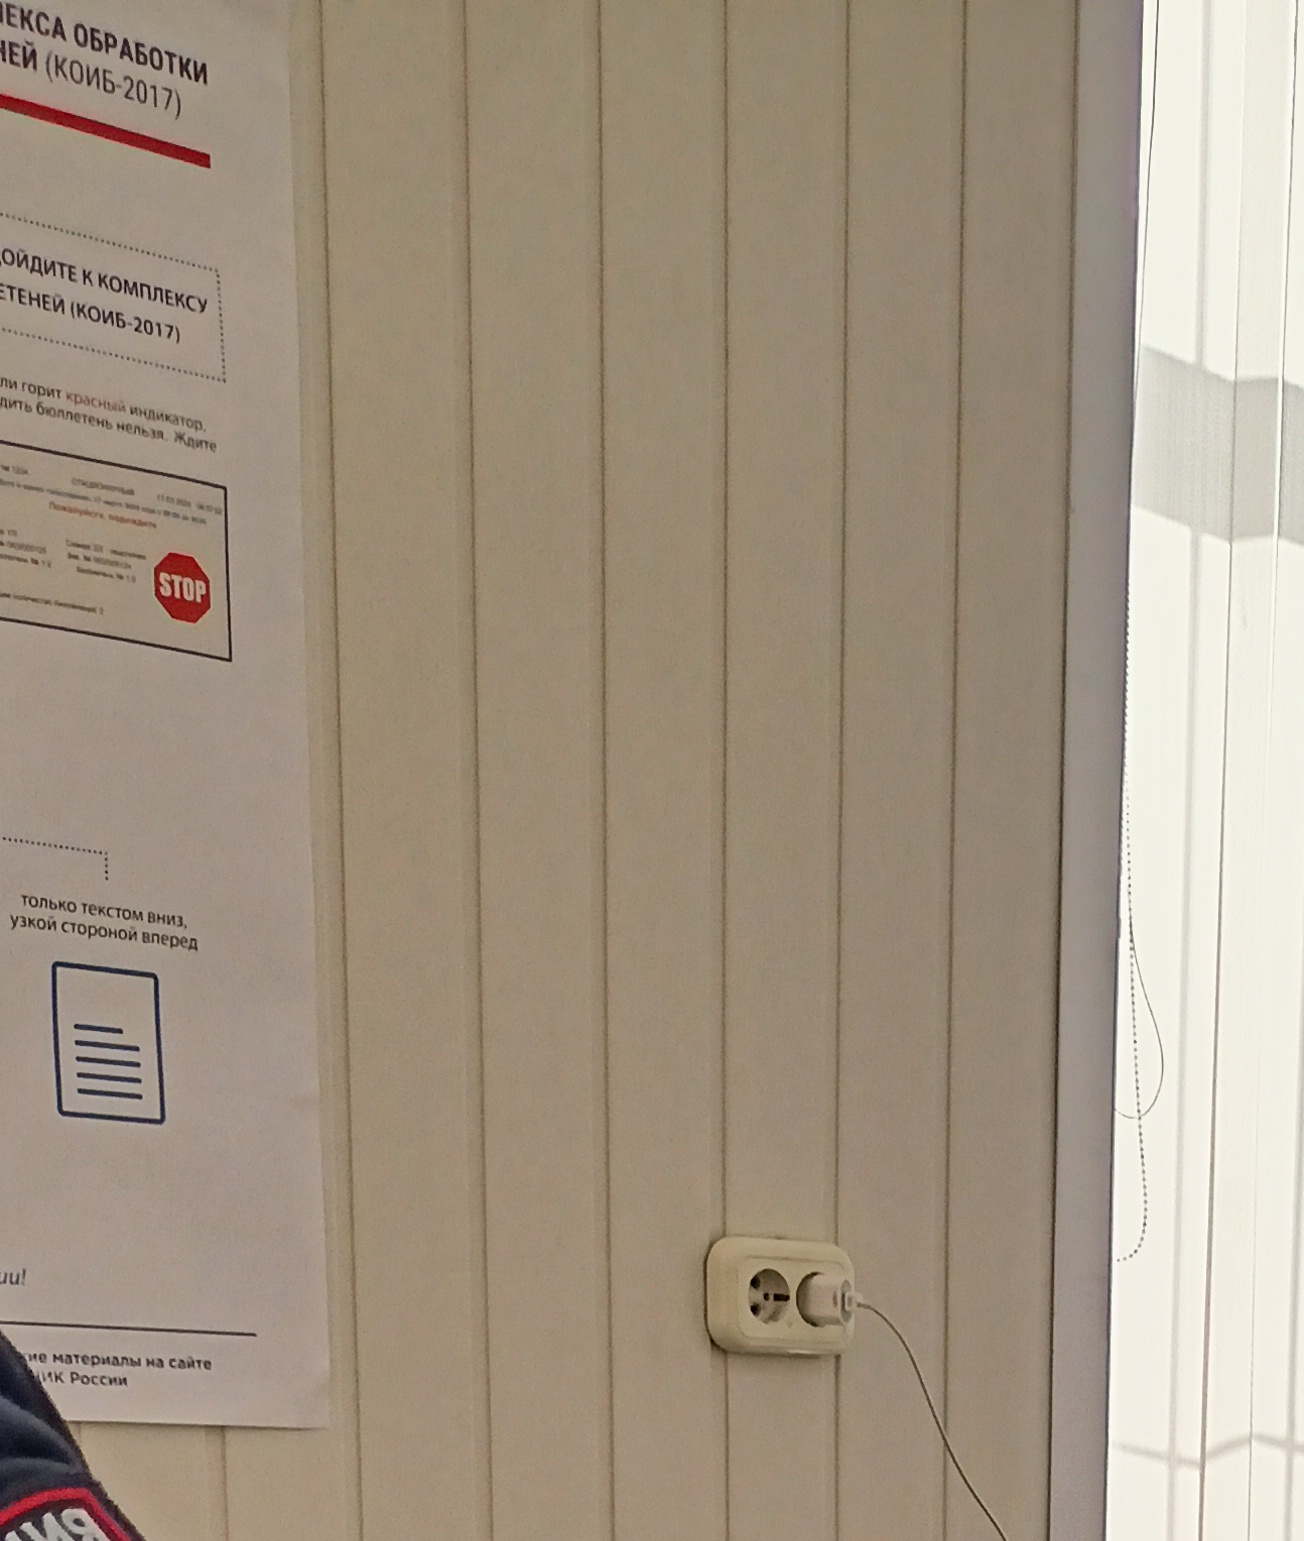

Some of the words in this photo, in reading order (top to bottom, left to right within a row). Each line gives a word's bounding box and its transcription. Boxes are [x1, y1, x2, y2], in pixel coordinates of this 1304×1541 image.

[0, 2, 67, 42] ЕКСА
[73, 23, 208, 86] ОБРАБОТКИ
[45, 50, 182, 120] (КОИБ-2017)
[0, 248, 78, 283] ОЙДИТЕ
[82, 269, 94, 287] К
[98, 271, 208, 314] КОМПЛЕКСУ
[70, 301, 181, 344] (КОИБ-2017)
[21, 380, 62, 399] горит
[66, 391, 126, 413] красный
[36, 402, 113, 430] бюллетень
[173, 431, 218, 453] Ждите
[158, 572, 206, 603] STOP
[21, 895, 77, 913] только
[82, 902, 144, 921] текстом
[10, 914, 57, 931] узкой
[61, 921, 138, 941] стороной
[142, 931, 198, 951] вперед
[23, 1352, 47, 1364] ие
[53, 1353, 142, 1368] материалы
[146, 1357, 164, 1369] на
[169, 1356, 212, 1371] сайте
[70, 1371, 128, 1388] России
